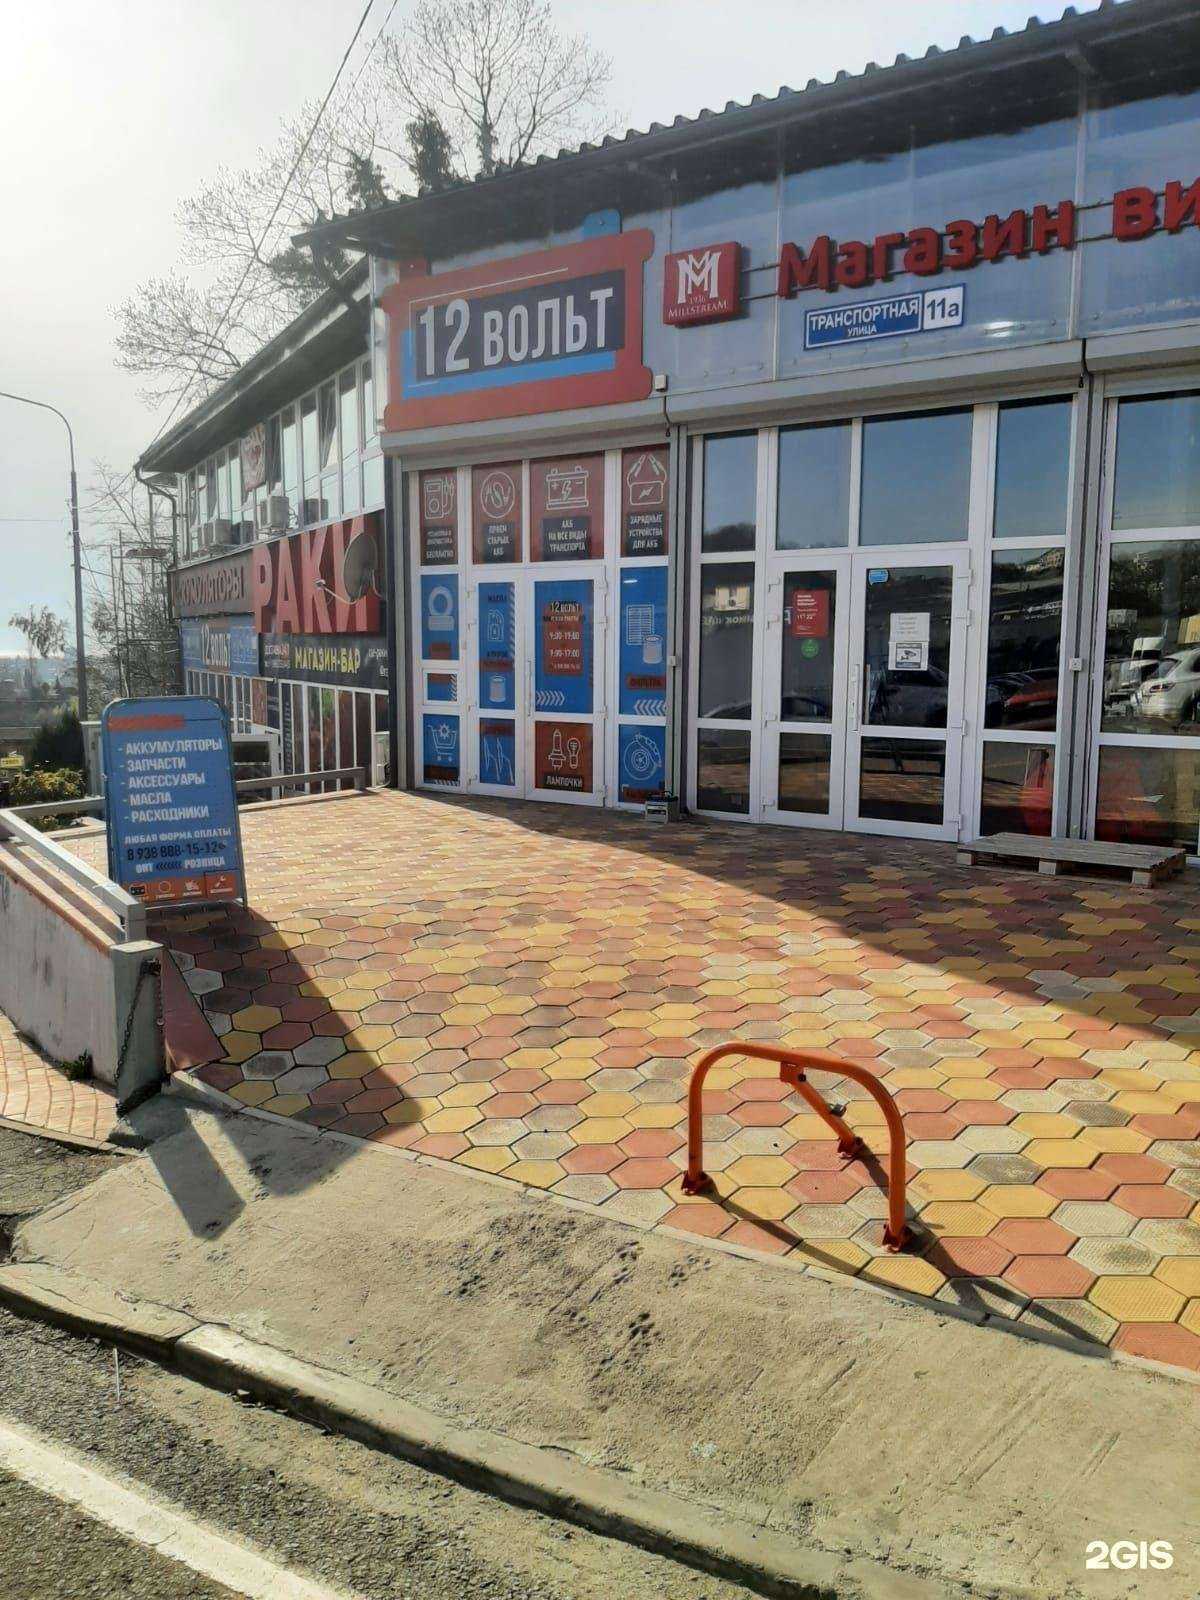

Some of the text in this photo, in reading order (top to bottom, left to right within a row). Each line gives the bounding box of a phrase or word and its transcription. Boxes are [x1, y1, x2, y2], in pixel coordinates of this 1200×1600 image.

[778, 200, 1075, 298] Магазин
[668, 300, 728, 321] MILLSTREAM
[810, 297, 960, 331] ТРАНСПОРТНАЯ 11а
[419, 299, 470, 375] 12
[847, 325, 877, 337] УЛИЦА
[557, 531, 568, 540] ВСЕ
[629, 528, 662, 537] УСТРОЙСТВА
[550, 542, 585, 552] ТРАНСПОРТА
[295, 647, 361, 673] МАГАЗИН-БАР
[125, 738, 222, 755] АККУМУЛЯТОРЫ
[128, 757, 186, 772] ЗАПЧАСТИ
[129, 772, 205, 789] АКСЕССУАРЫ
[546, 776, 583, 788] ЛАМПОЧКИ
[130, 792, 171, 806] МАСЛА
[131, 806, 209, 823] РАСХОДНИКИ
[125, 828, 231, 844] ЛЮБАЯ ФОРМА ОПЛАТЫ
